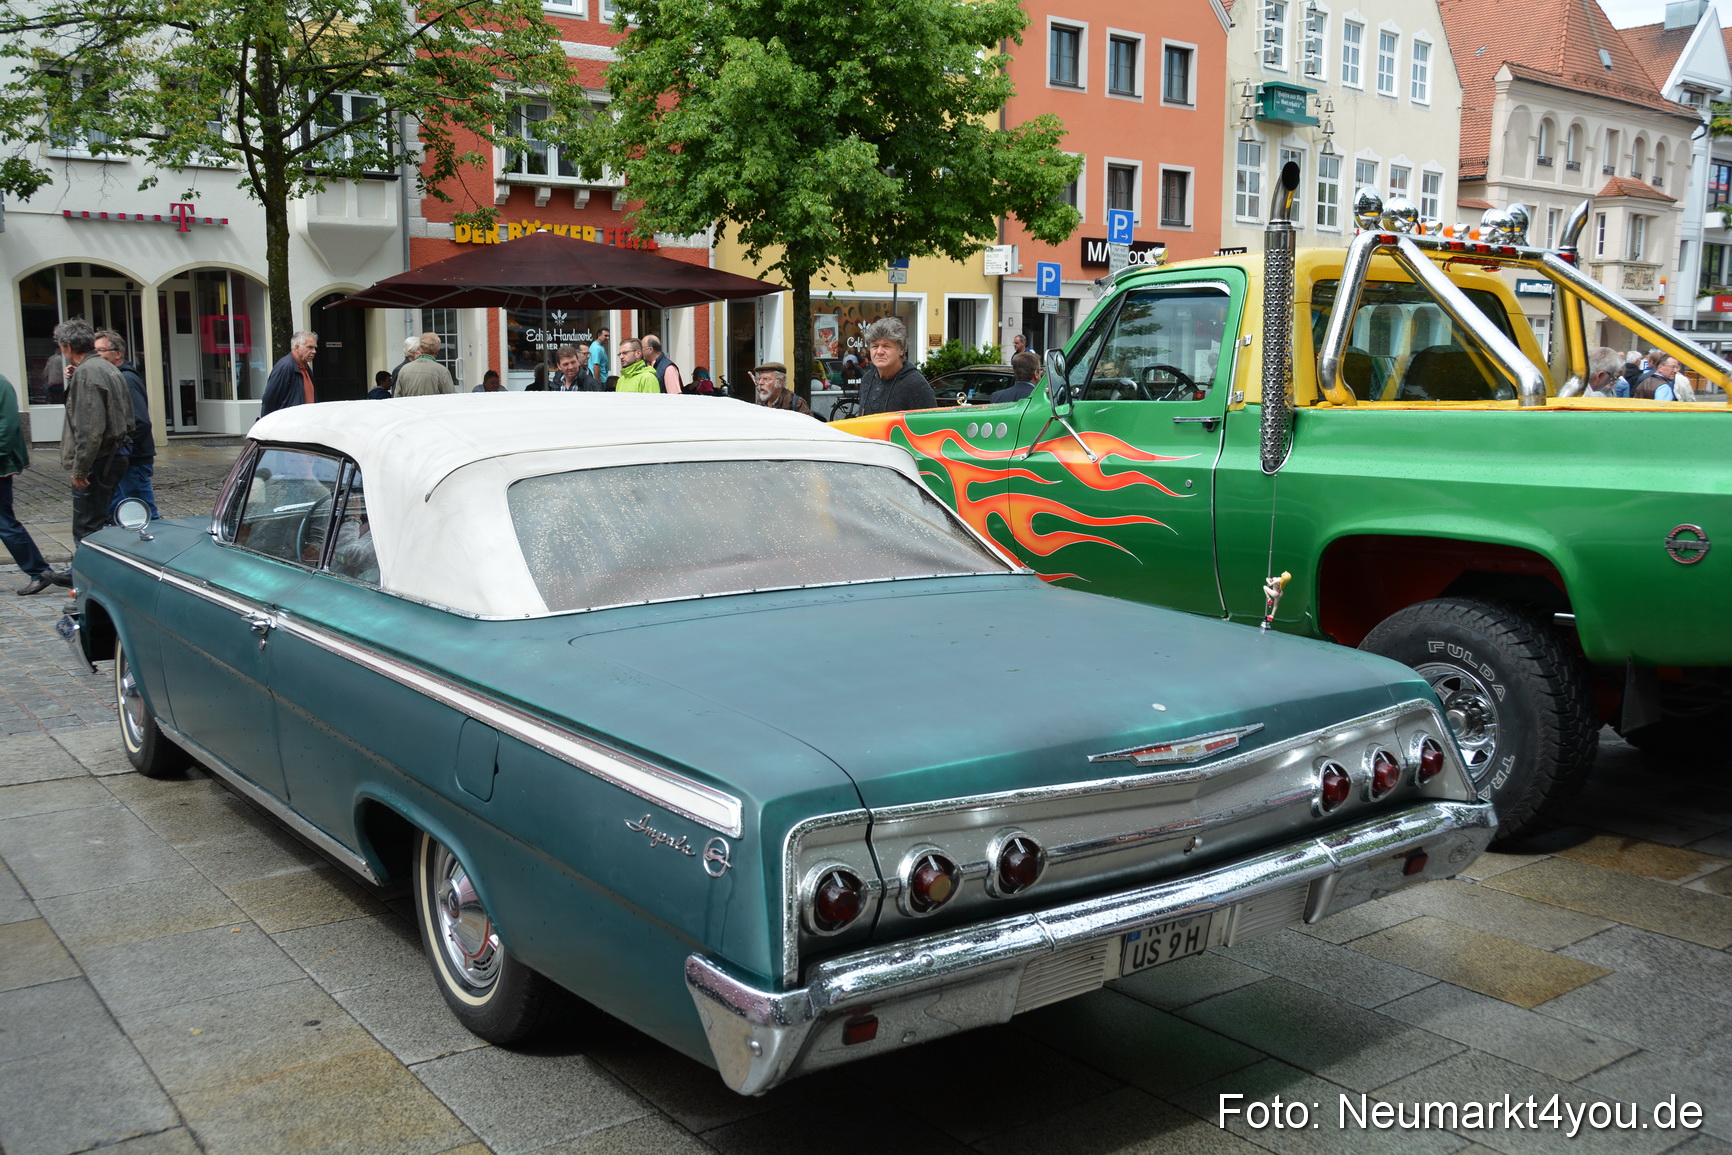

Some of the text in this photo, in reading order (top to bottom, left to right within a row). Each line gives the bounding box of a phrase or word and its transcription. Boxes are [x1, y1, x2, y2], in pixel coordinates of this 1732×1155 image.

[170, 203, 195, 232] T
[1114, 214, 1128, 239] P
[455, 221, 500, 244] DER
[1088, 241, 1111, 262] MA
[1042, 266, 1056, 292] P
[526, 328, 553, 342] Eches
[847, 336, 864, 352] Café
[1428, 641, 1505, 702] FULDA
[624, 814, 696, 856] Impala
[1132, 938, 1161, 969] US
